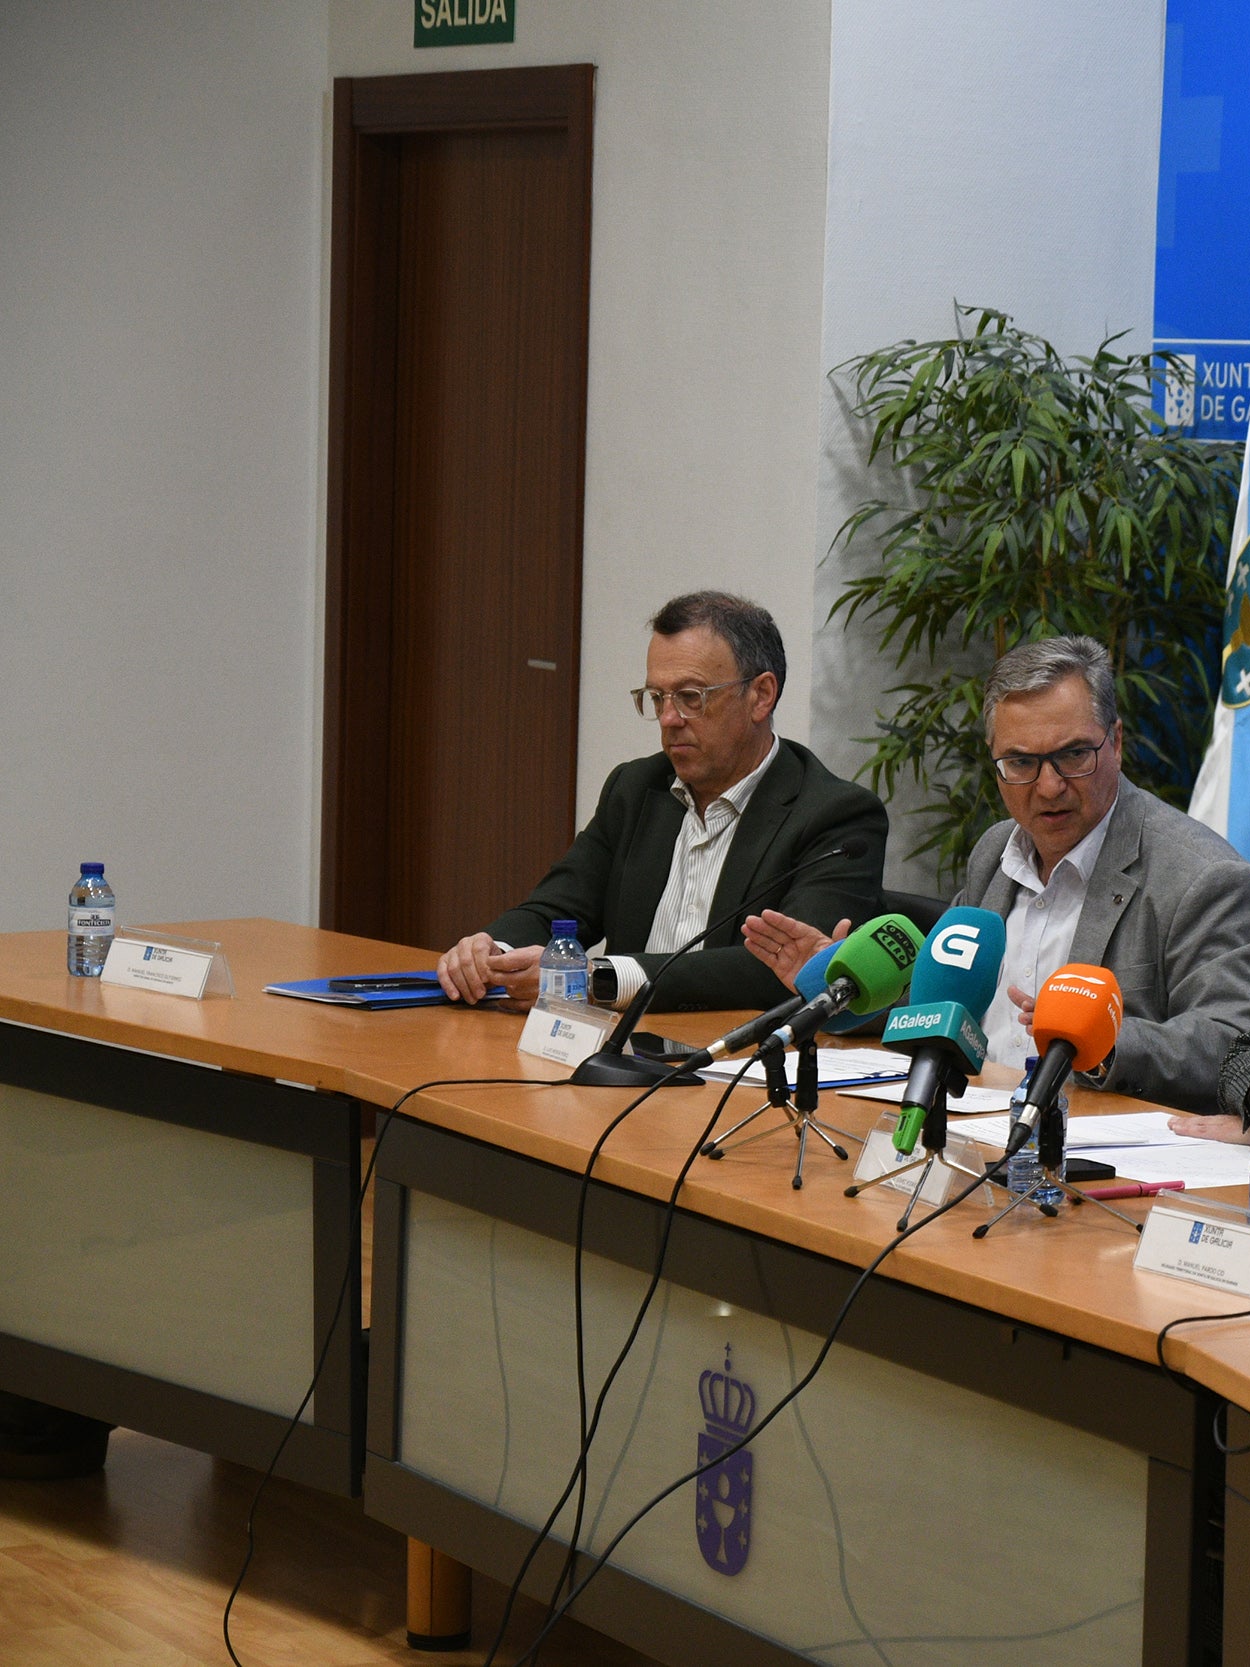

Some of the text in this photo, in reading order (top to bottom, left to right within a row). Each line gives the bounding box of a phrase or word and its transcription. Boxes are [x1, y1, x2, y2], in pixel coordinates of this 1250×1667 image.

[421, 0, 507, 29] SALIDA
[1201, 394, 1225, 420] DE
[931, 924, 980, 970] G
[1048, 983, 1098, 1000] telemiño
[888, 1013, 942, 1031] AGalega
